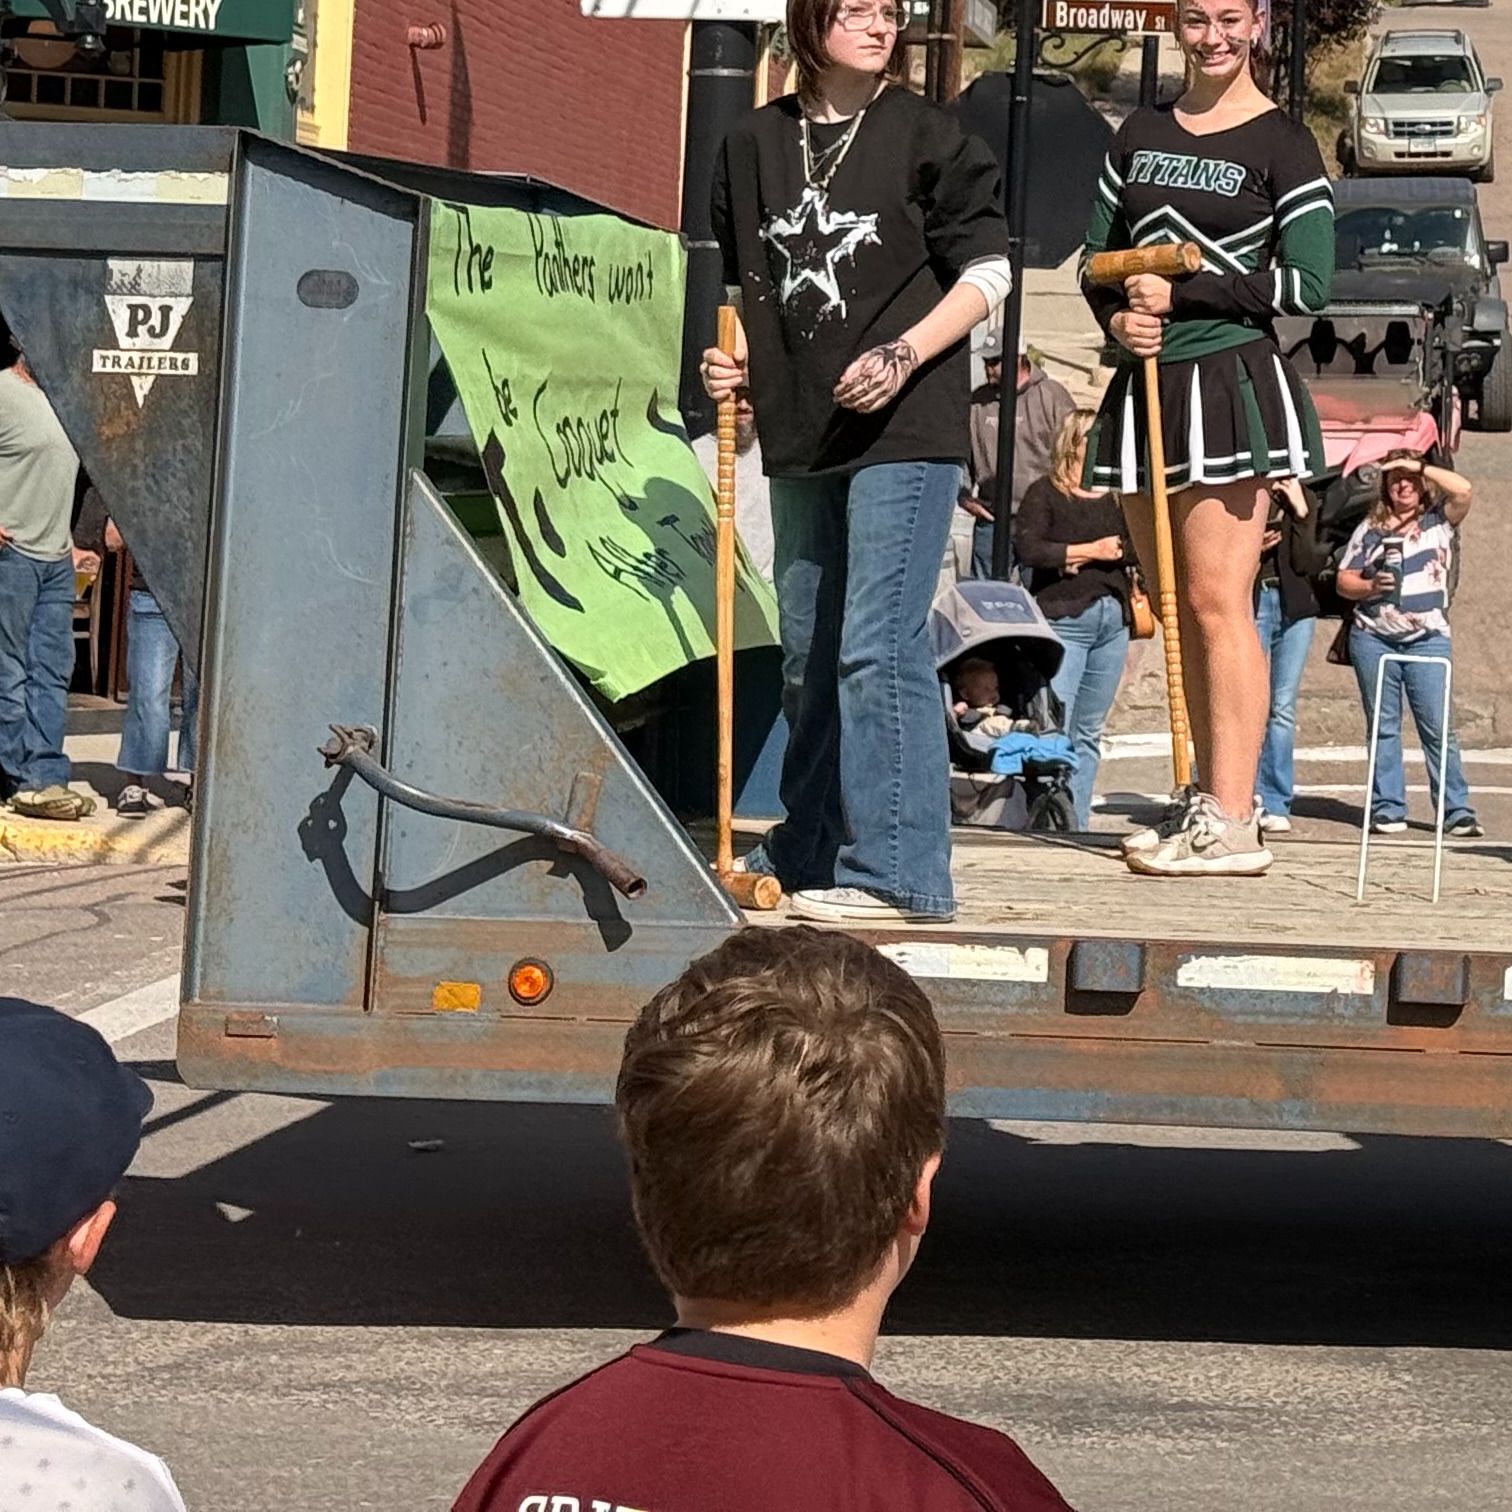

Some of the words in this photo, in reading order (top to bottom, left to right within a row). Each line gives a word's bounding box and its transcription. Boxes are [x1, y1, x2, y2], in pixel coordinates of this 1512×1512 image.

[1056, 1, 1148, 33] Broadway
[1127, 150, 1247, 197] TITANS
[441, 201, 495, 297] The
[526, 211, 596, 305] Panthers
[124, 303, 175, 339] PJ
[99, 354, 191, 373] TRAILERS
[481, 347, 519, 427] be
